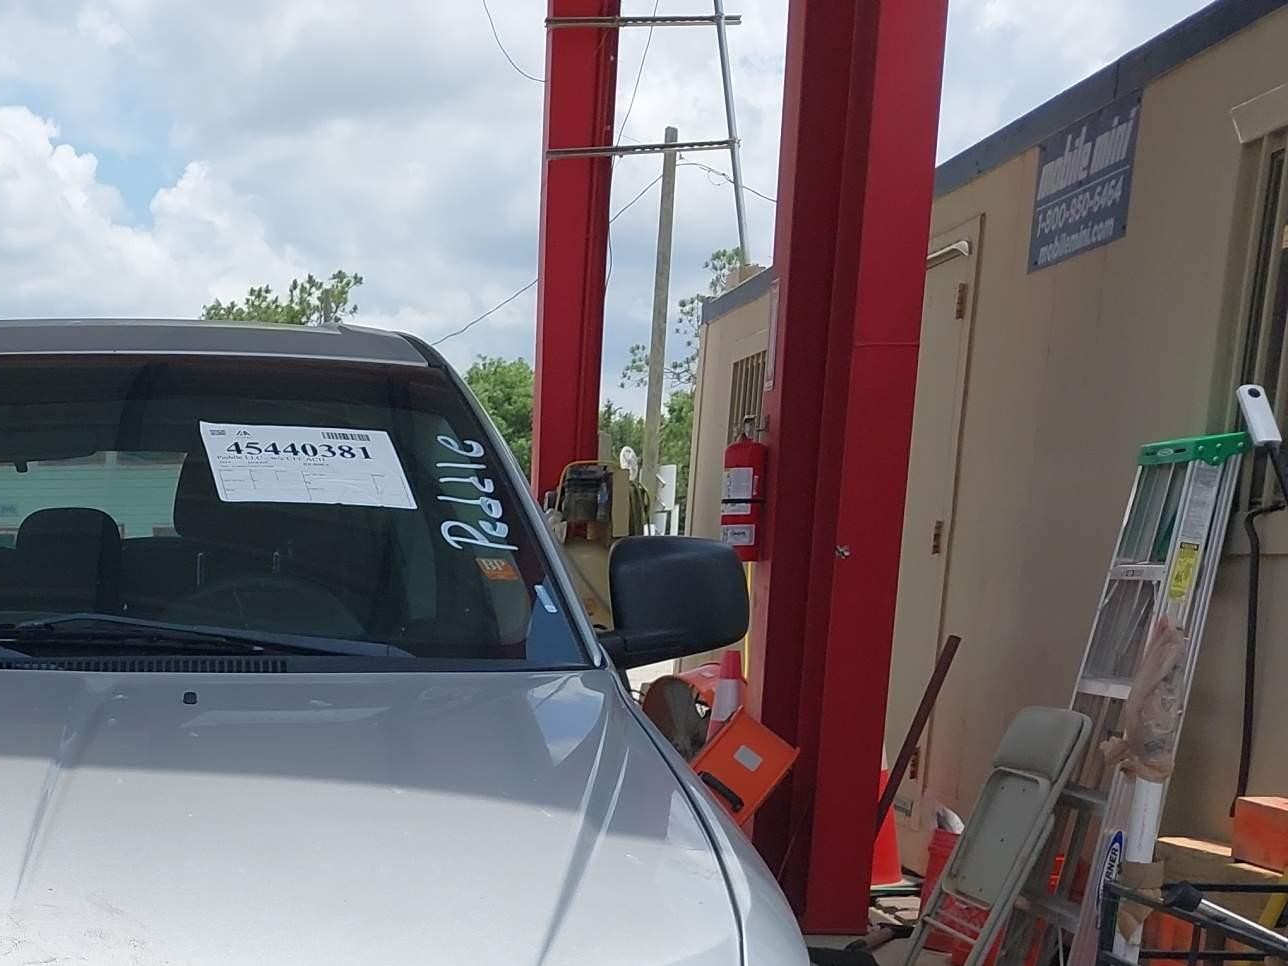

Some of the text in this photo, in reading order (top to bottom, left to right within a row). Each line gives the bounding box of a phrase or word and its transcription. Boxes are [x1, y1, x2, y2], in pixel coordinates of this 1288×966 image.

[1037, 104, 1140, 201] mobile mini
[226, 440, 375, 460] 45440381
